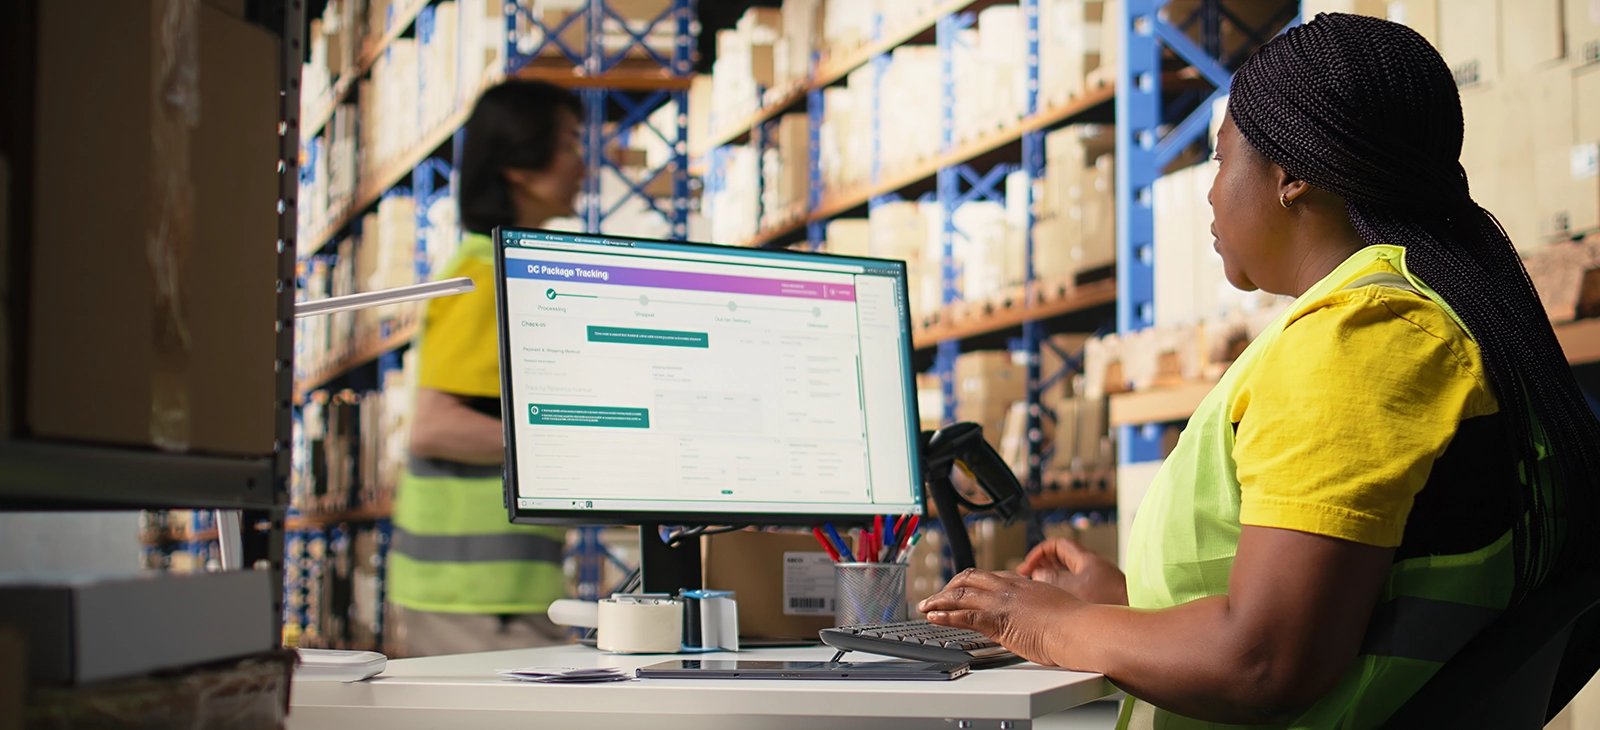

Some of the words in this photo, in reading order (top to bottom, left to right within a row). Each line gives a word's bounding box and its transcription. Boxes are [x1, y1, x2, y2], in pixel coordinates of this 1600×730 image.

[527, 264, 540, 274] DC
[541, 266, 574, 278] Package
[576, 268, 609, 280] Tracking
[538, 304, 566, 313] Processing
